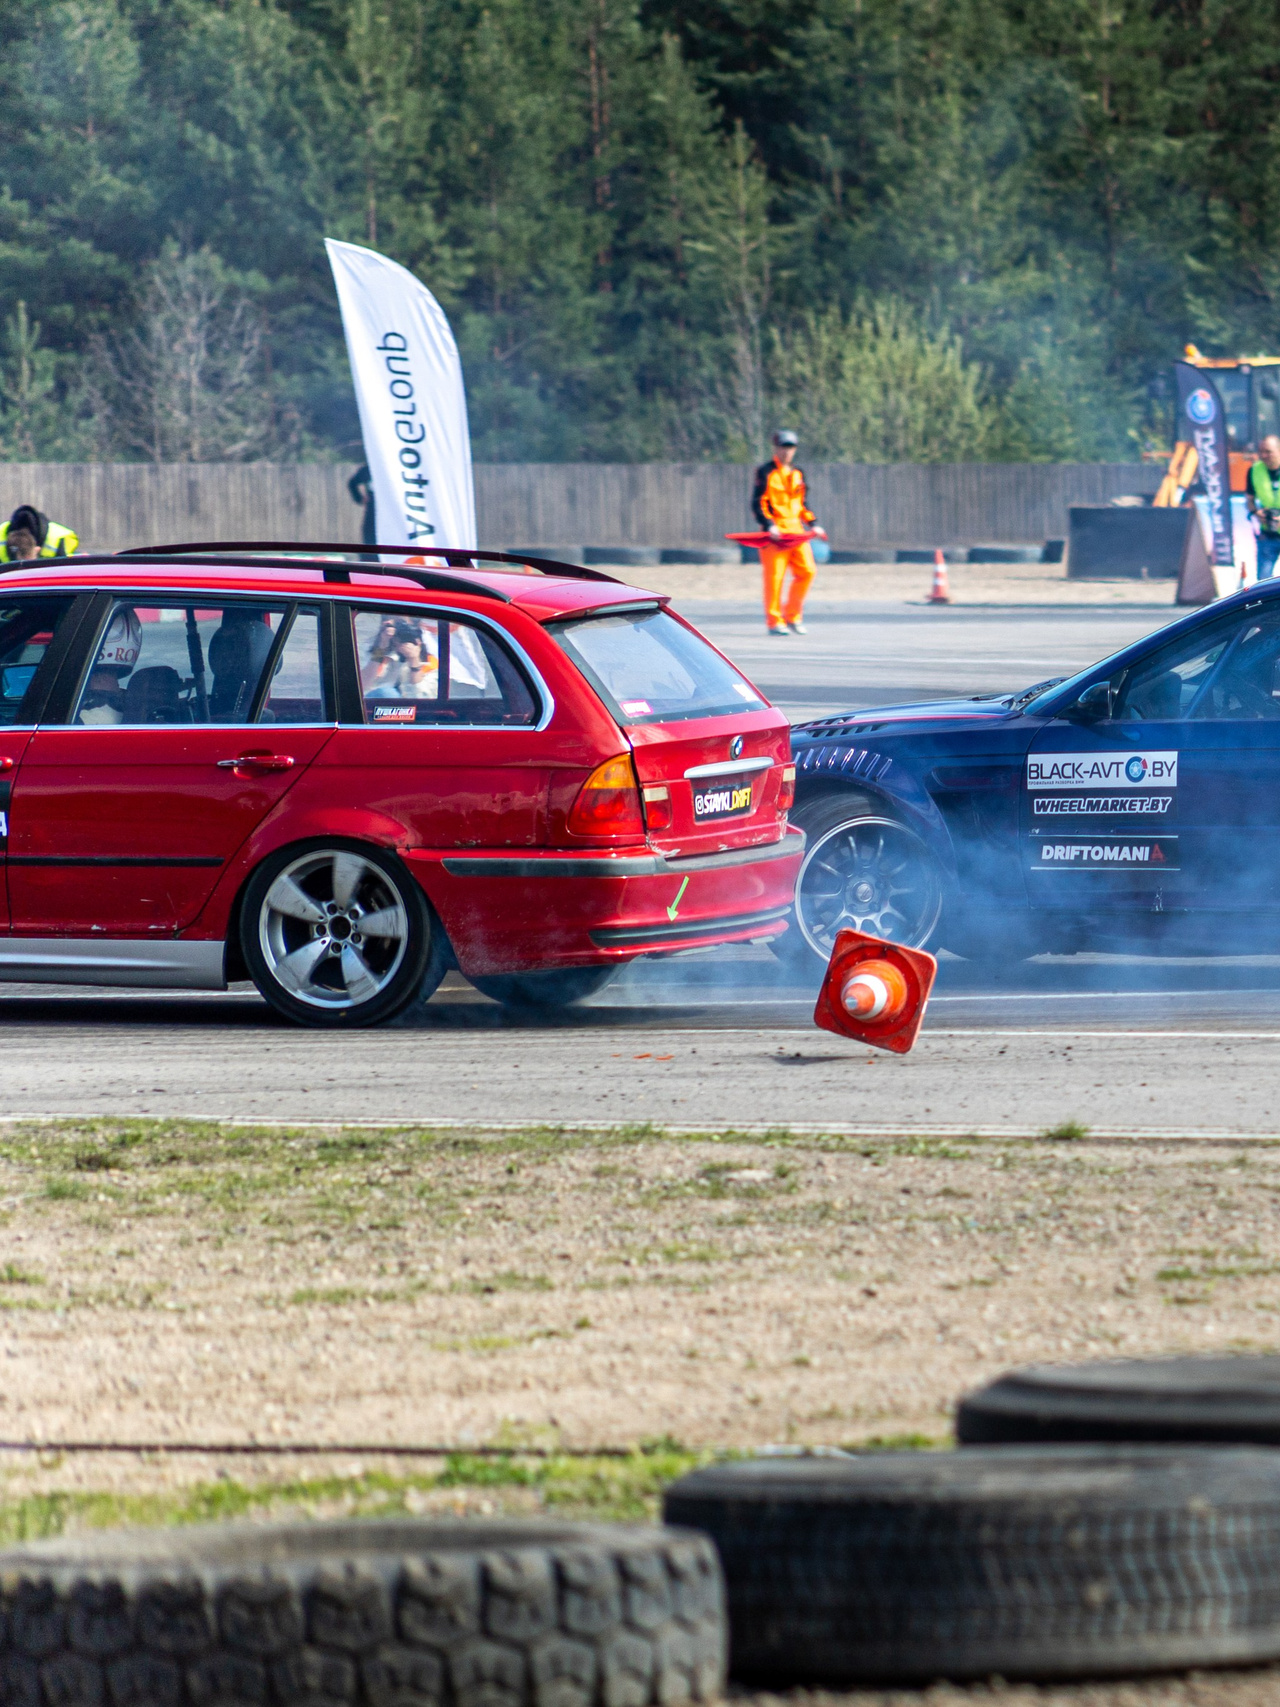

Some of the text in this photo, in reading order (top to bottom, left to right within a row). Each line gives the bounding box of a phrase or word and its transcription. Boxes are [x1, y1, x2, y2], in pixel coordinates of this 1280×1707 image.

[695, 787, 751, 815] @STAYKI_DRIFT
[1034, 797, 1172, 814] WHEELMARKET.BY
[1042, 844, 1165, 862] DRIFTOMANIA
